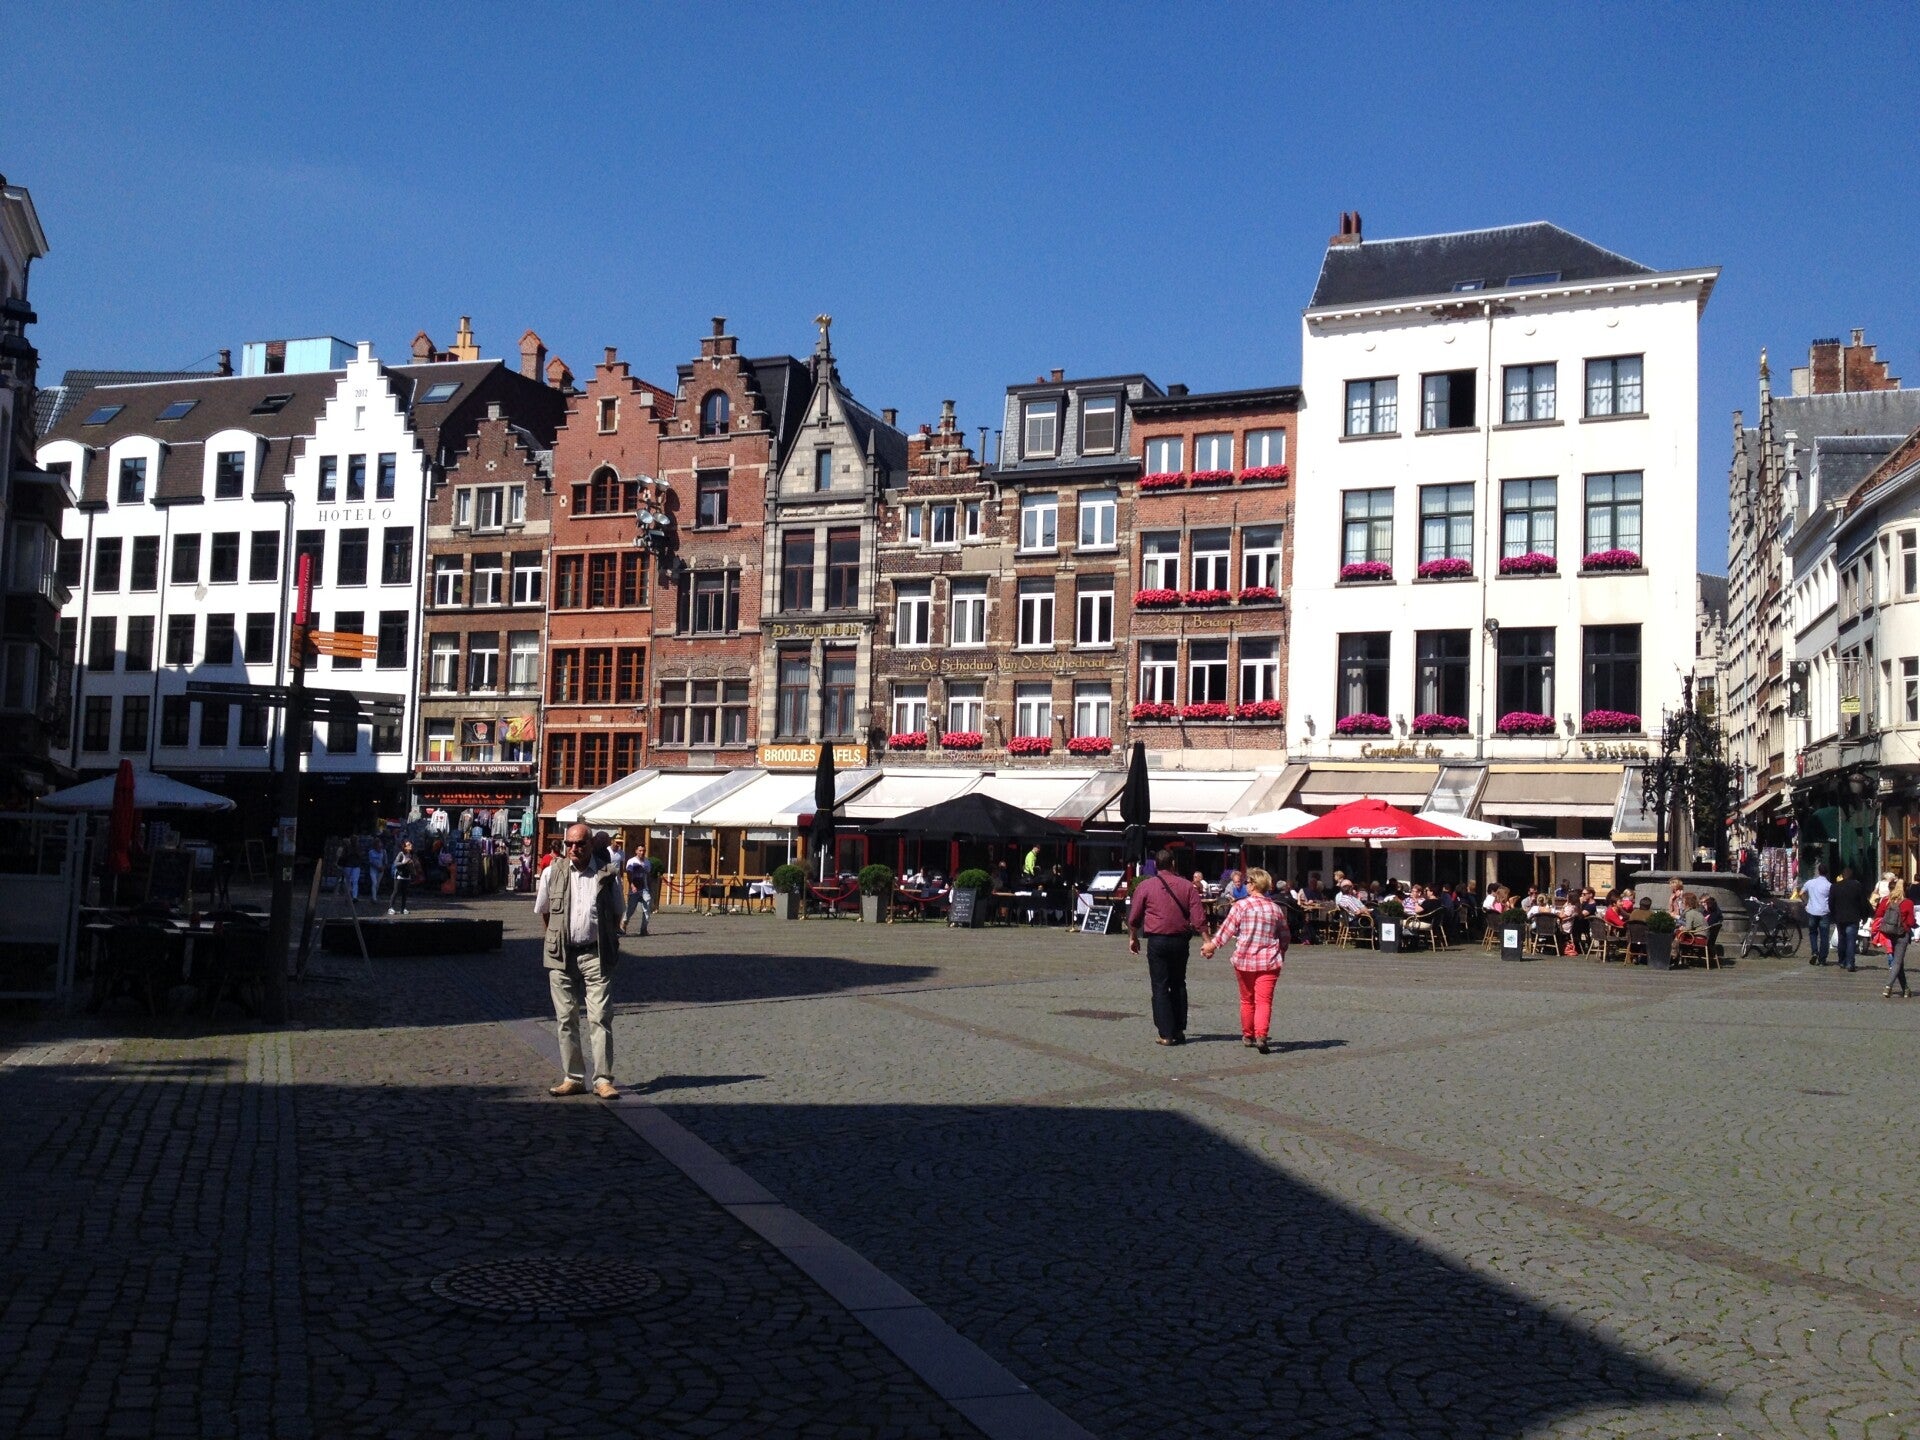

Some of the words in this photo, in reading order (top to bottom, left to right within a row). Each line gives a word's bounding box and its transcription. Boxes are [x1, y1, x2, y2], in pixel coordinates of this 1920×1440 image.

[355, 389, 368, 398] 2012
[318, 509, 375, 522] HOTEL
[771, 624, 791, 638] De
[907, 660, 918, 672] In
[920, 657, 937, 671] De
[941, 658, 994, 672] Schaduw
[997, 657, 1018, 670] Van
[1020, 656, 1039, 670] De
[1041, 655, 1105, 670] Kathedraal
[764, 749, 816, 762] BROODJES
[832, 749, 861, 762] AFELS
